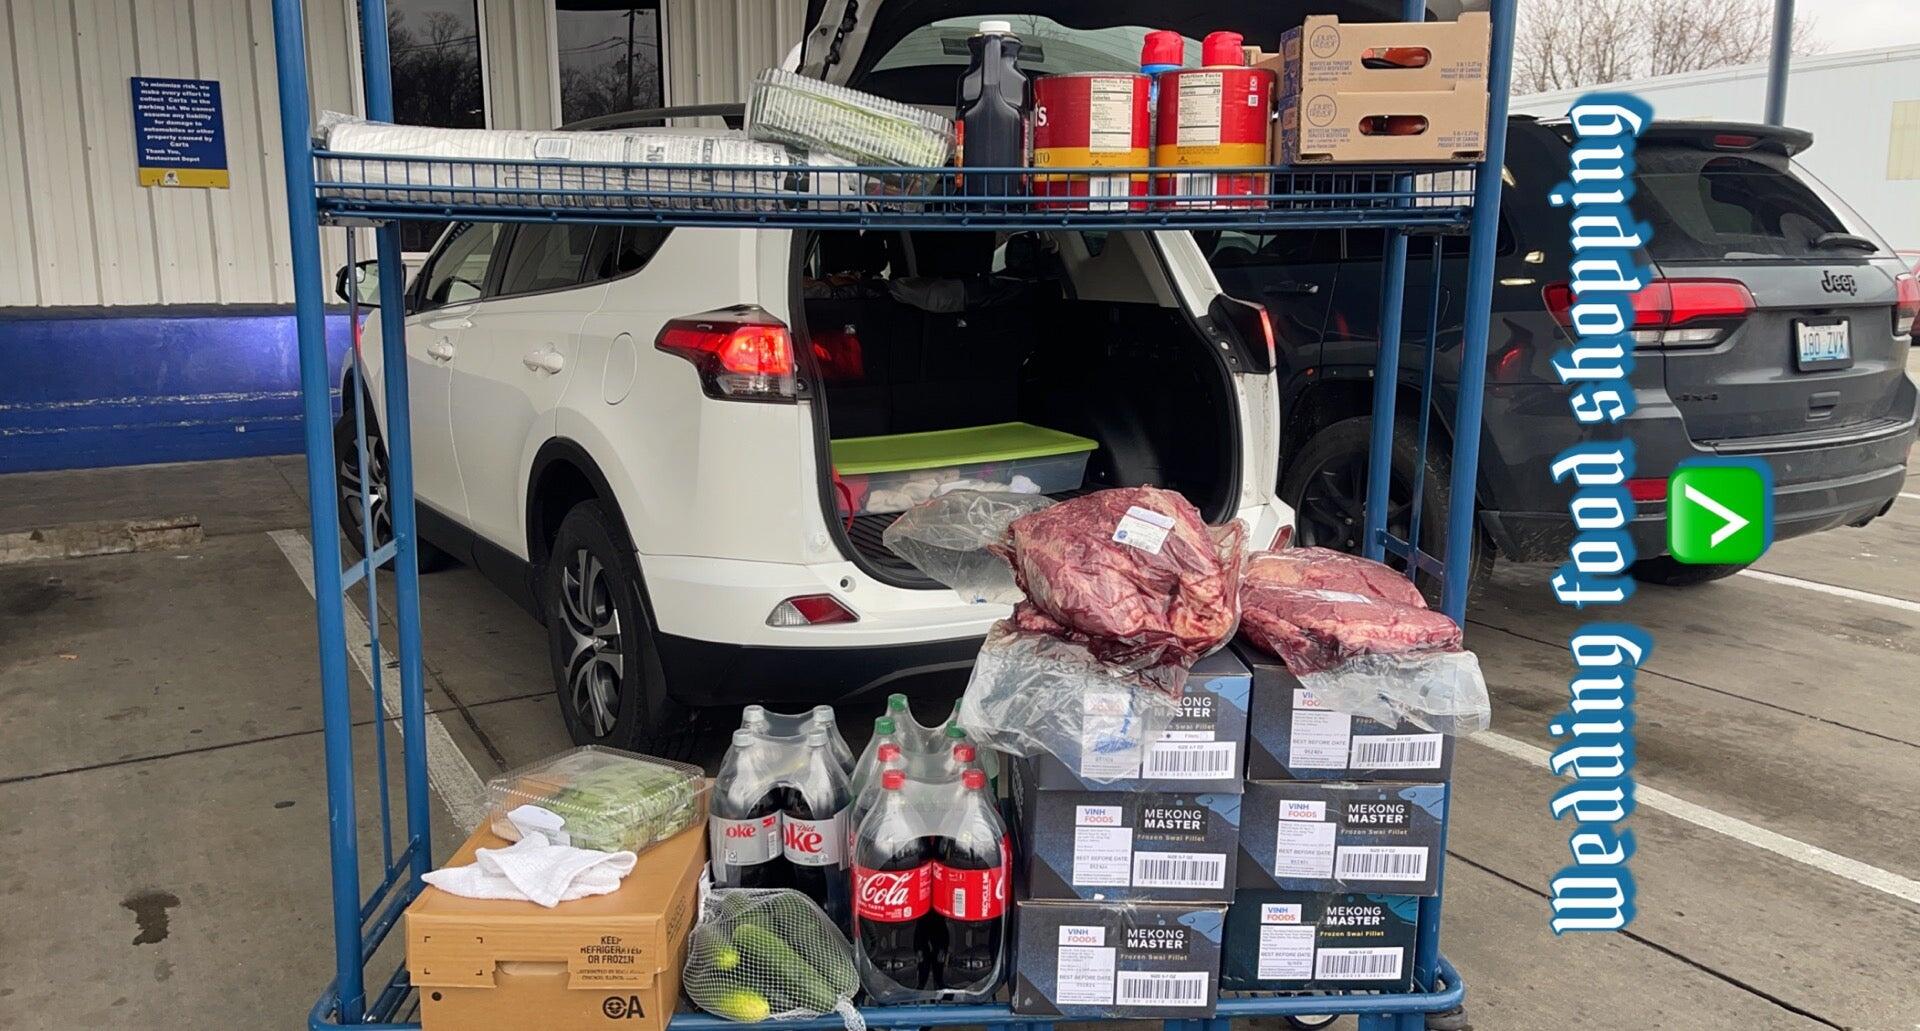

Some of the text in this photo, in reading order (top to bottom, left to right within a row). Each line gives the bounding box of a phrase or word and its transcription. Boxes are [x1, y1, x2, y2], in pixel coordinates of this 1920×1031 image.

[147, 134, 176, 142] property
[1821, 270, 1857, 296] Jeep
[1827, 332, 1844, 354] ZVX
[1084, 808, 1106, 816] VINH
[1144, 808, 1202, 820] MEKONG
[1288, 810, 1317, 818] FOODS
[1348, 804, 1405, 814] MEKONG
[1348, 814, 1404, 824] MASTER
[798, 824, 816, 832] Diet
[1144, 820, 1200, 830] MASTER
[1340, 828, 1366, 836] Frozen
[982, 871, 990, 883] ME
[862, 872, 914, 906] Cola
[1268, 906, 1288, 914] VINH
[1327, 906, 1382, 916] MEKONG
[1327, 916, 1380, 926] MASTER
[1068, 928, 1088, 936] VINH
[1128, 929, 1184, 940] MEKONG
[600, 936, 622, 944] KEEP
[1128, 940, 1183, 950] MASTER
[580, 946, 642, 954] REFRIGERATED
[588, 955, 634, 964] OR FROZEN
